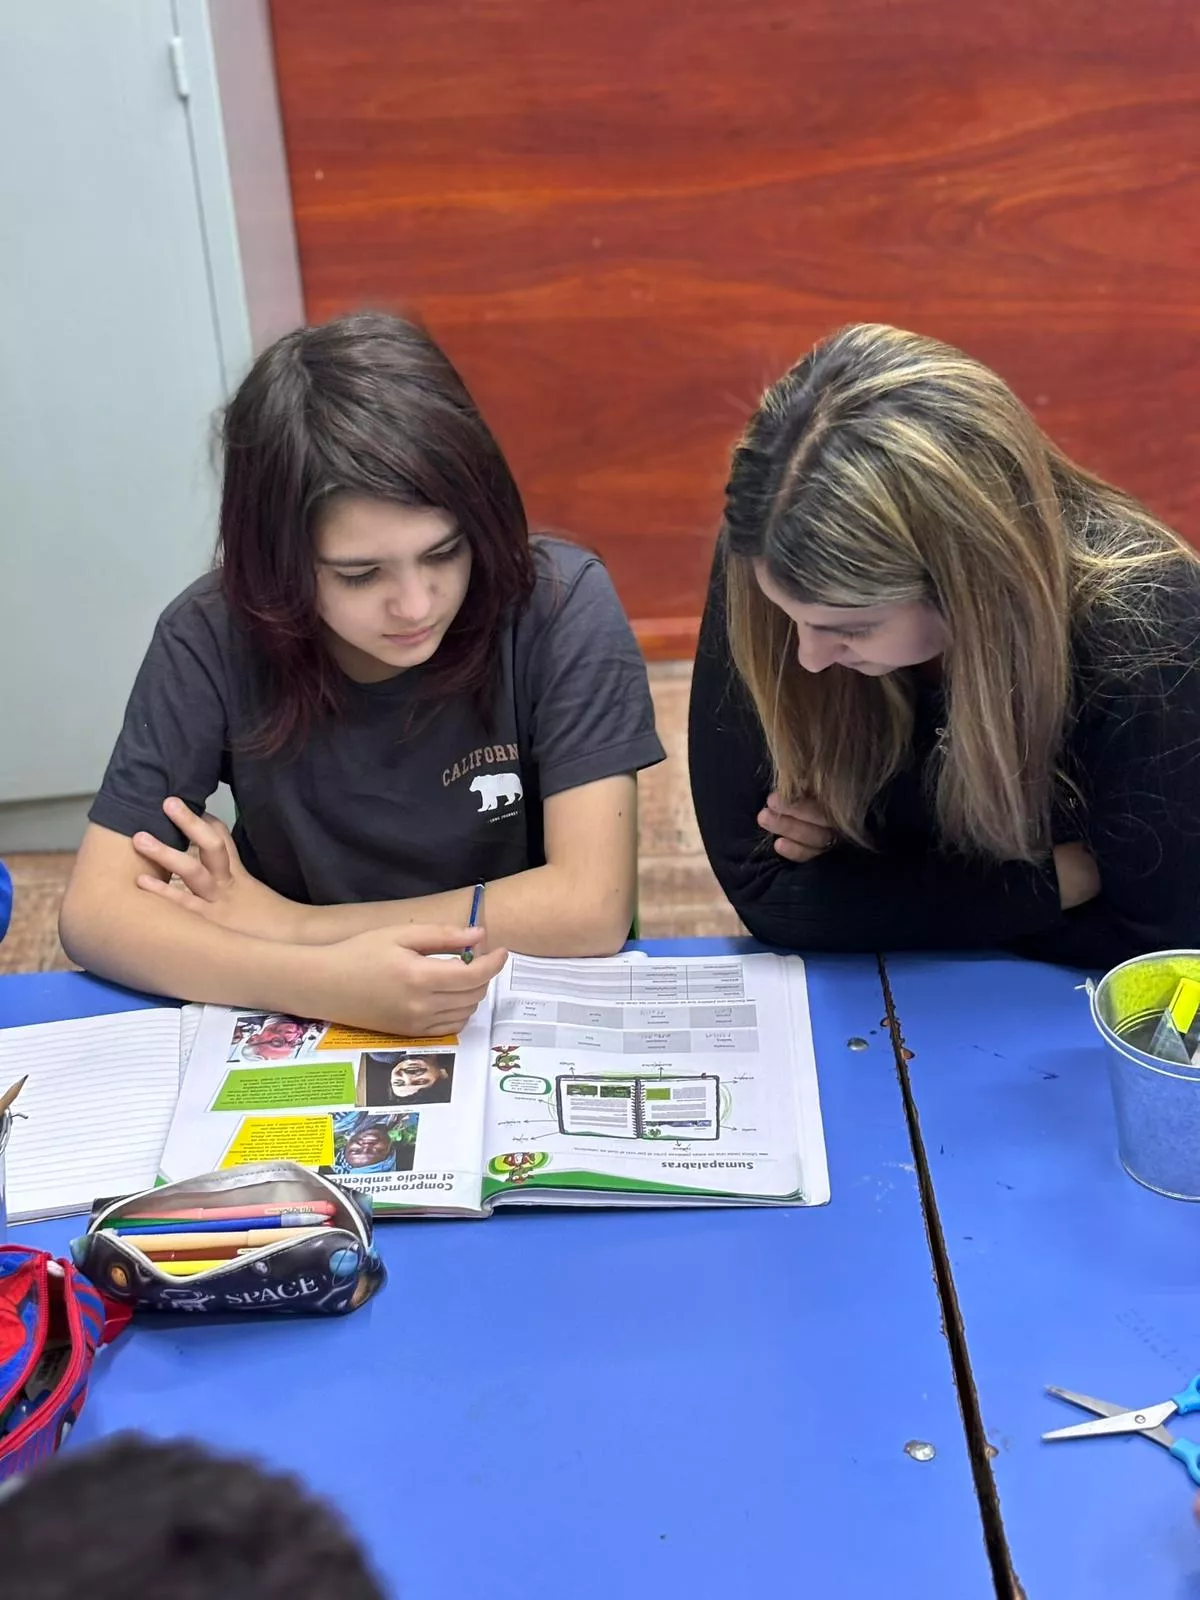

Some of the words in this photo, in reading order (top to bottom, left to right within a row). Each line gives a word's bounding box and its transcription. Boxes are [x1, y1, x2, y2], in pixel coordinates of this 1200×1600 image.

[661, 1159, 754, 1170] Sumapalabras
[397, 1173, 437, 1183] medio
[442, 1173, 454, 1182] el
[352, 1181, 453, 1195] Comprometido
[224, 1277, 319, 1304] SPACE
